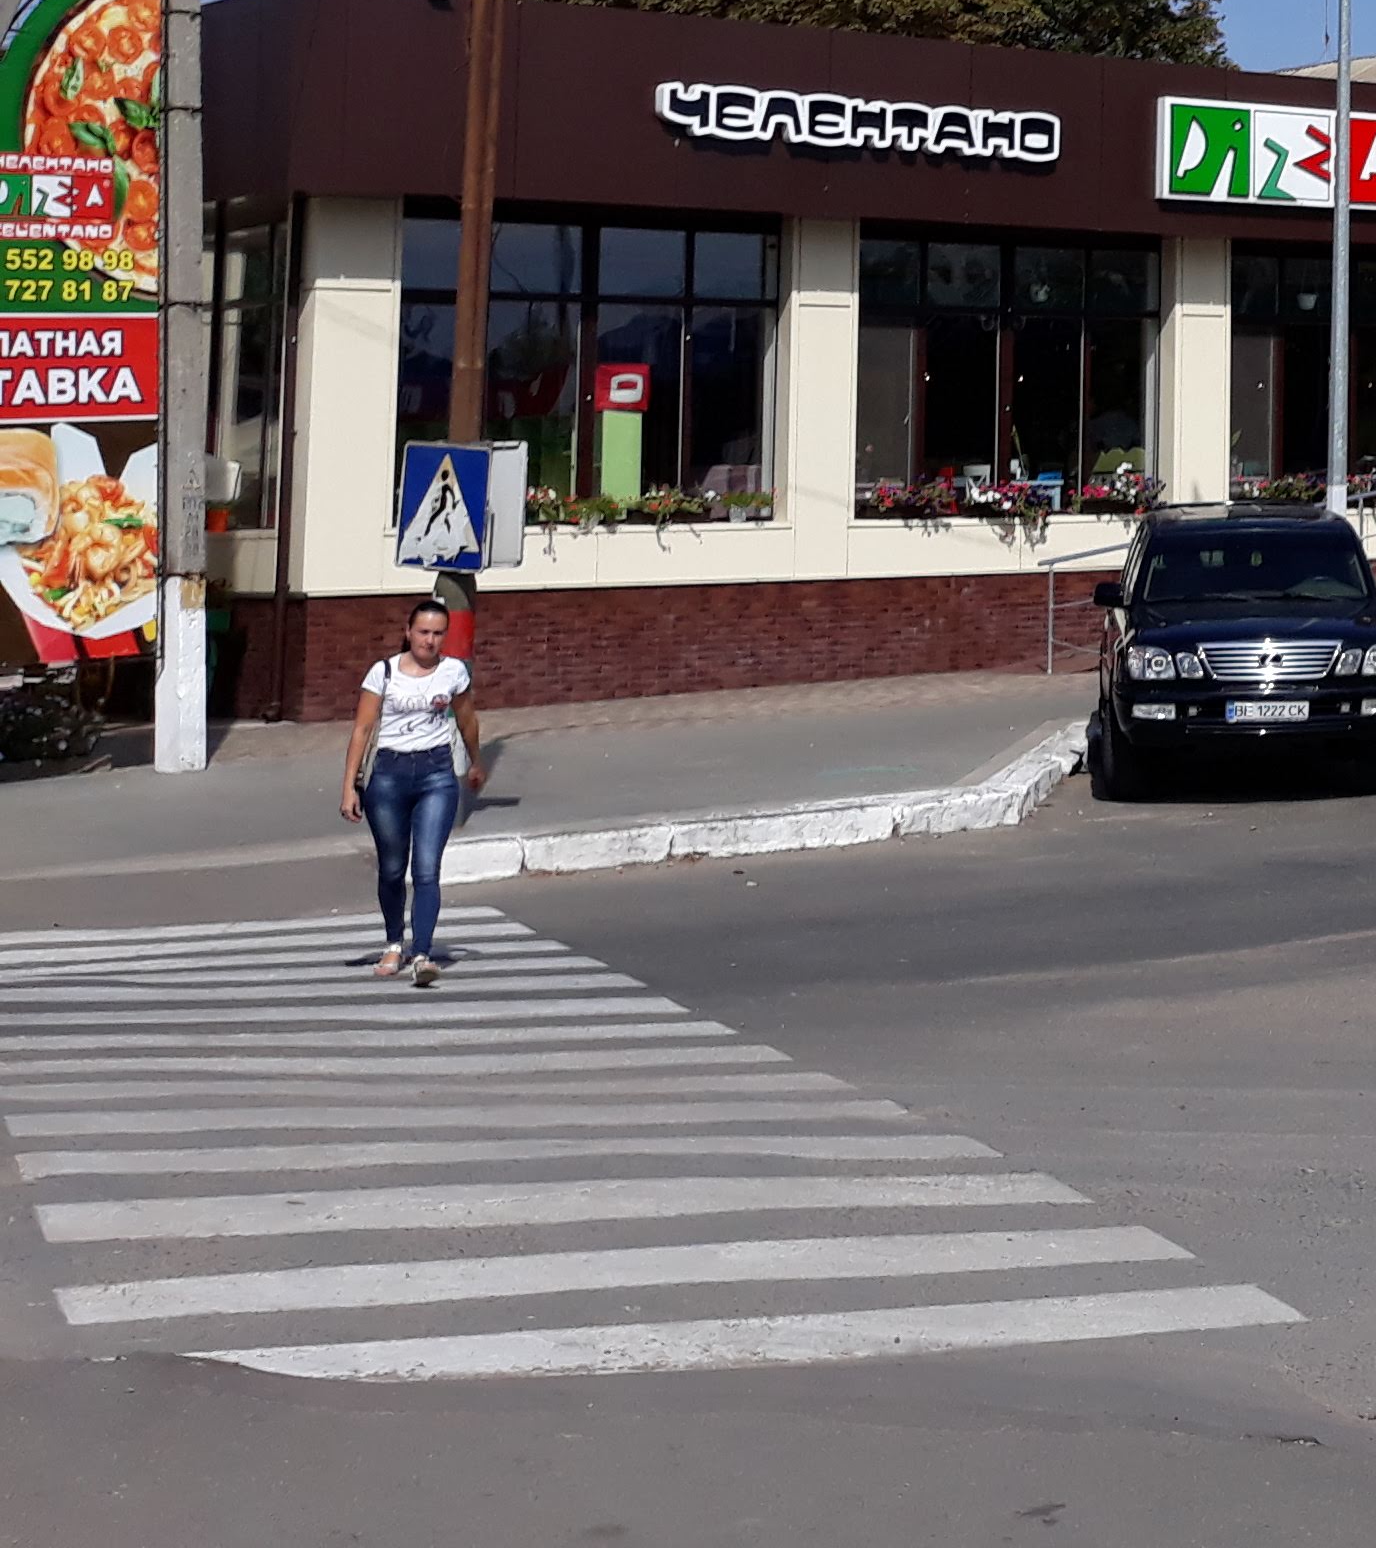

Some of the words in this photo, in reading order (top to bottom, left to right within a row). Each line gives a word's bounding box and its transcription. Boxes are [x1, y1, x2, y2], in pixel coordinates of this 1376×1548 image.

[659, 83, 1060, 161] ЧЕЛЕНТАНО
[0, 155, 113, 173] ЕЛЕНТАНО
[0, 222, 112, 238] ELENTANO
[5, 248, 54, 271] 552
[62, 249, 94, 271] 98
[102, 249, 134, 271] 98
[5, 279, 54, 301] 727
[62, 279, 92, 301] 81
[102, 280, 134, 301] 87
[1234, 705, 1253, 716] BE
[1288, 704, 1306, 716] CK
